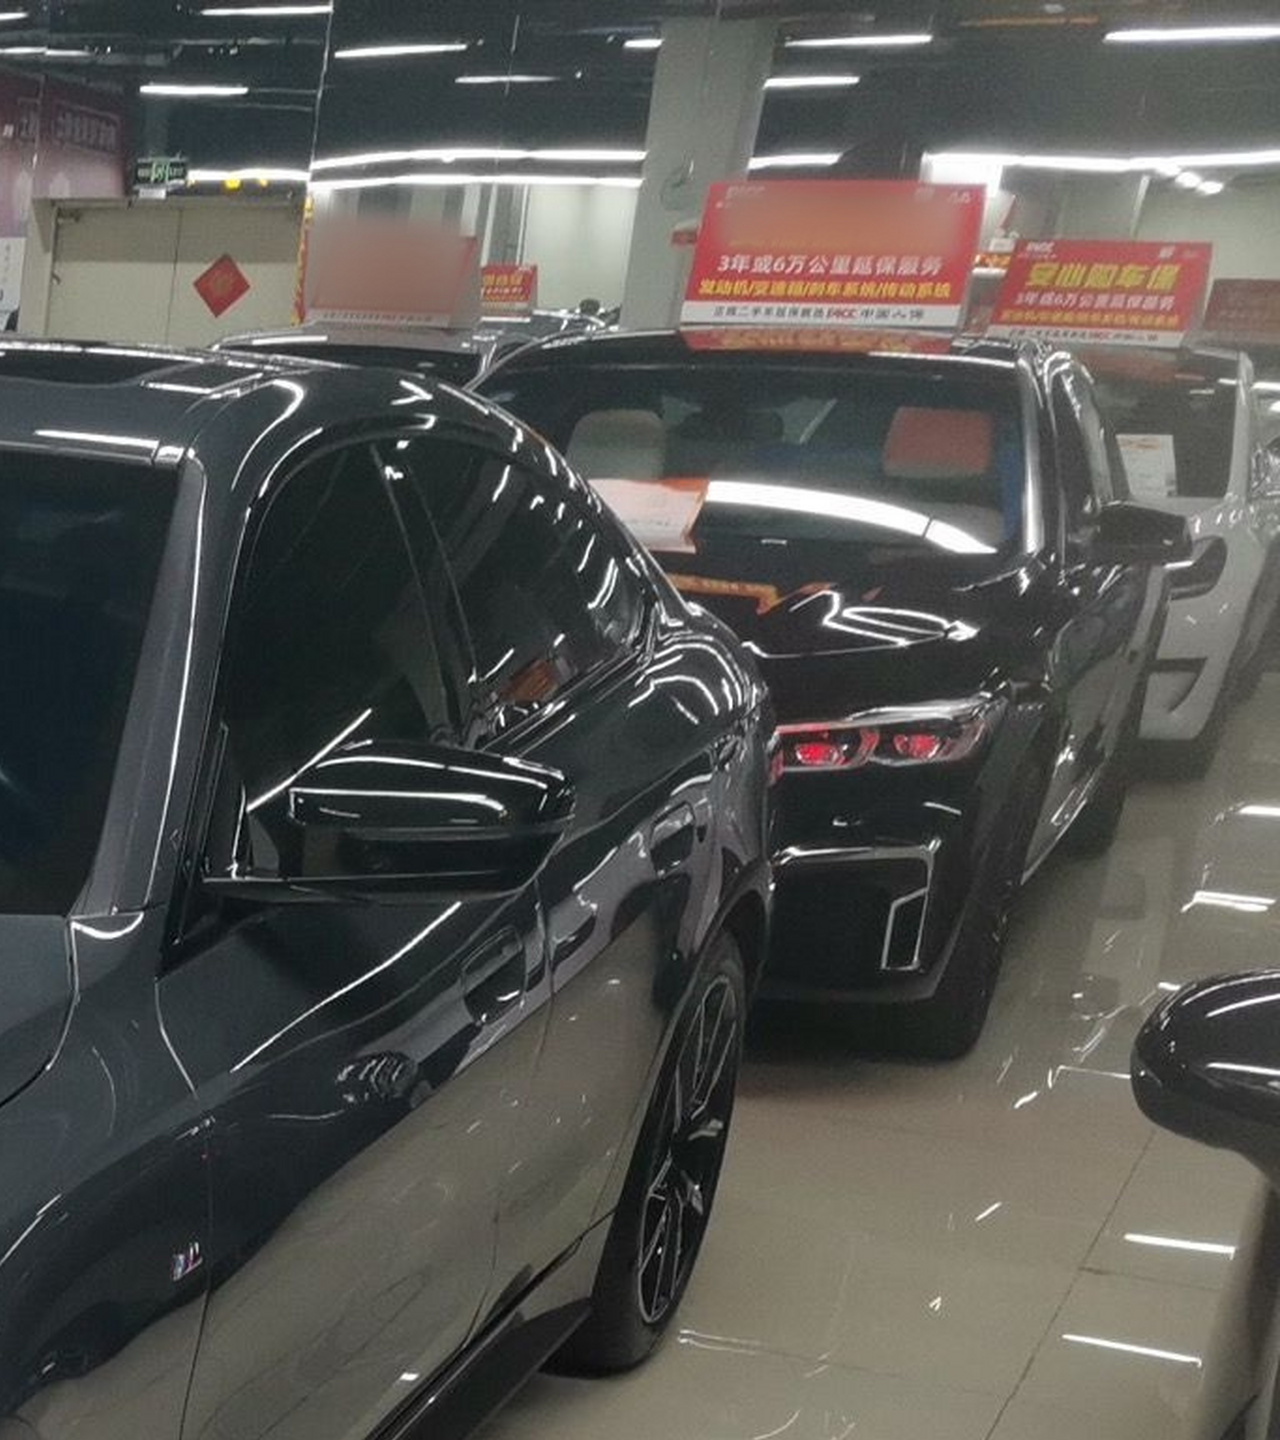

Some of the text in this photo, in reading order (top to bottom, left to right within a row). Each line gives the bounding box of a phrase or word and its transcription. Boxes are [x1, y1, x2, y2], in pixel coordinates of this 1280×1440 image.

[717, 254, 943, 276] 3年或6万公里延保服务
